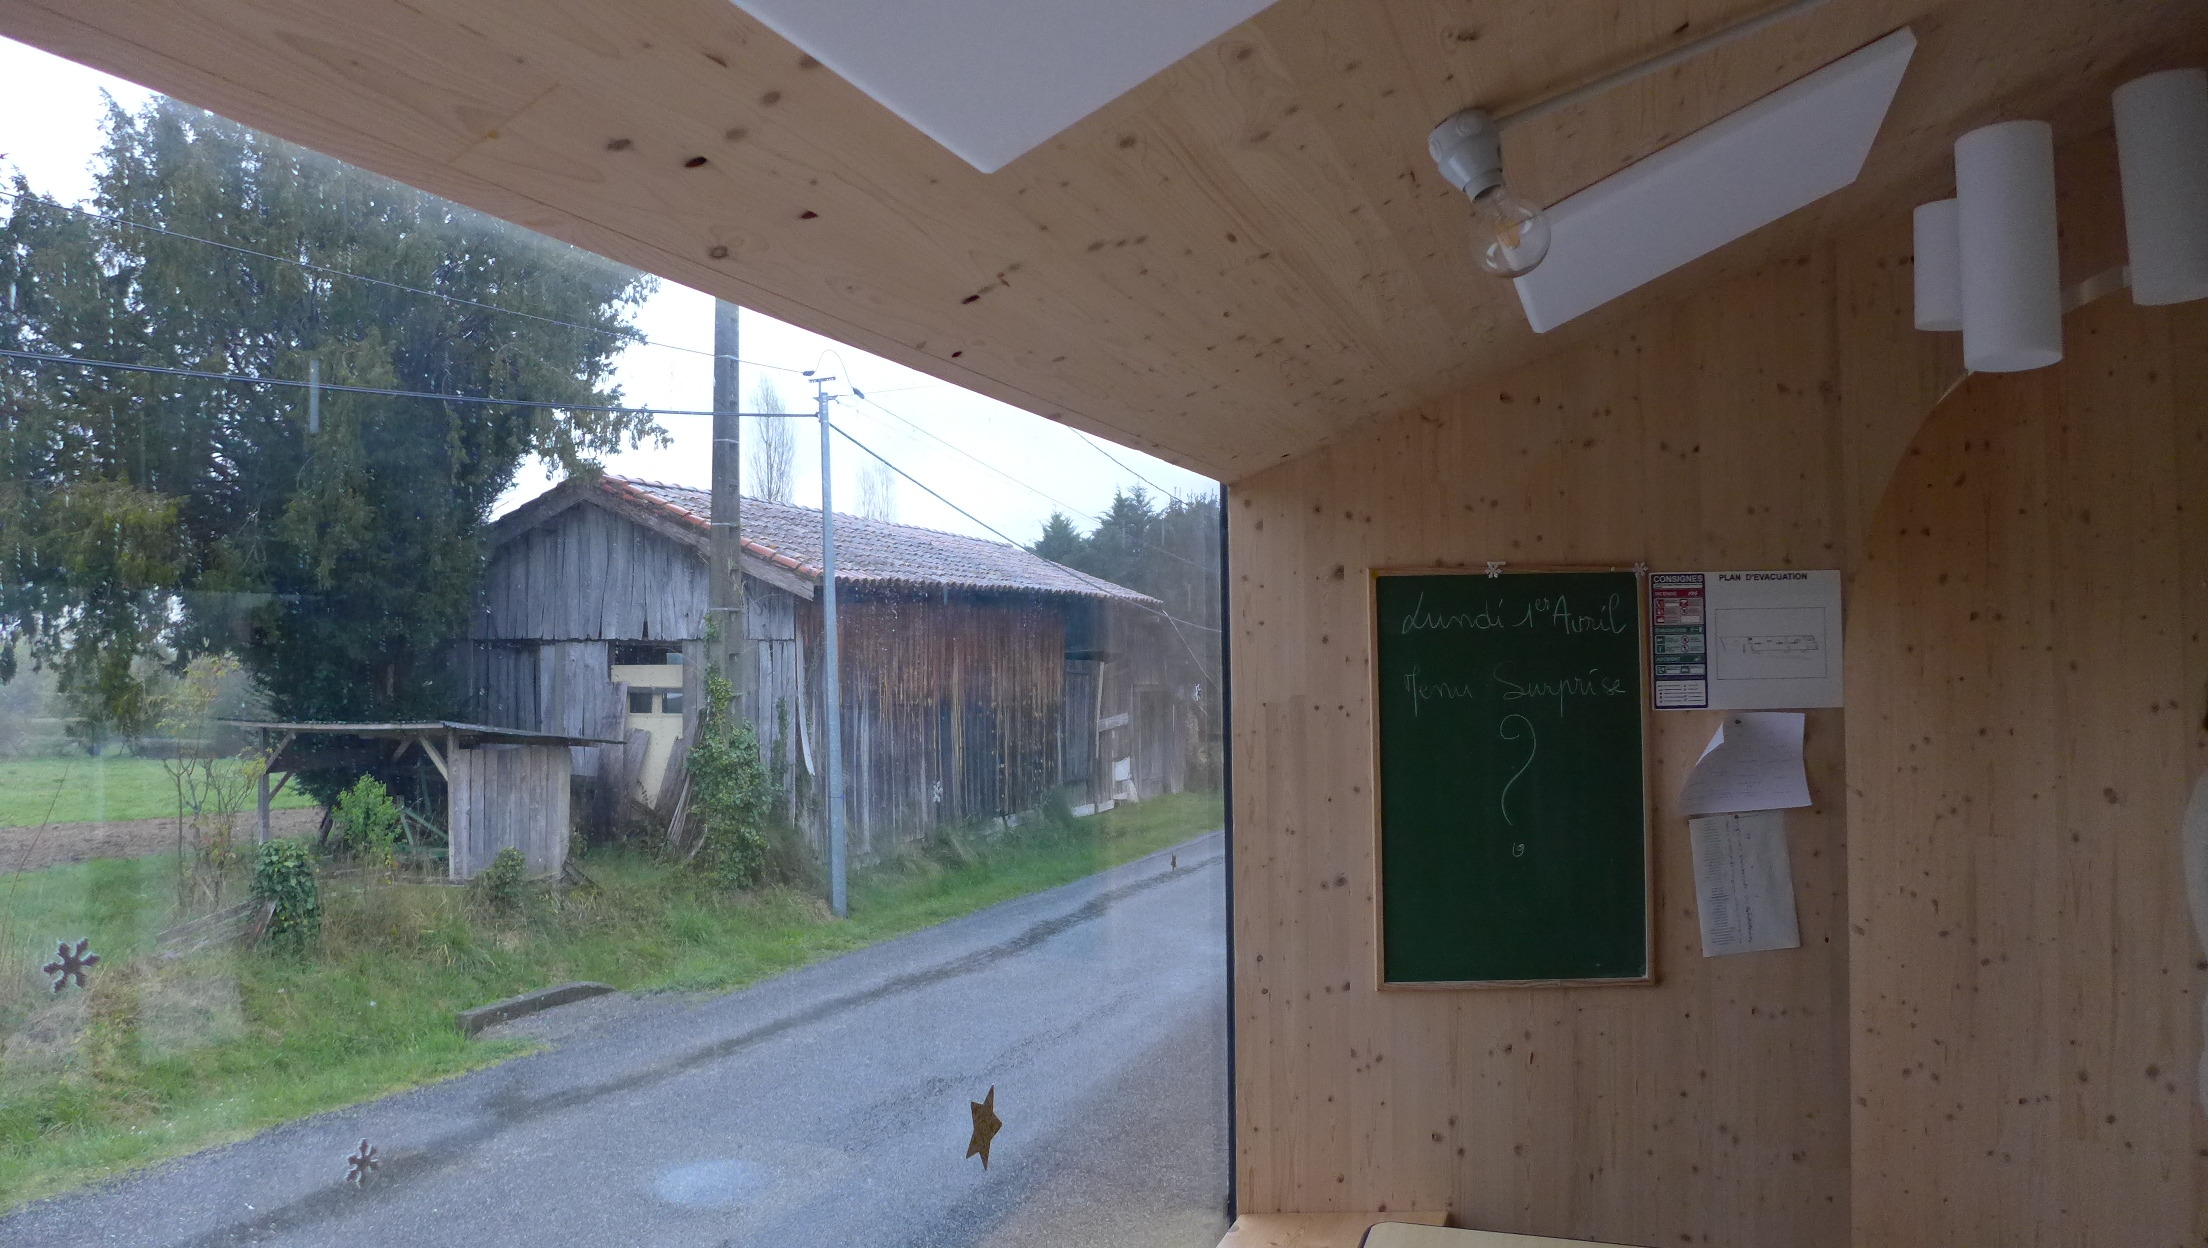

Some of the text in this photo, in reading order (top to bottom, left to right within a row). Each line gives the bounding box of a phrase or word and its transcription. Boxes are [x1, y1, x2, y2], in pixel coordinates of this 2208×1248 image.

[1653, 574, 1703, 583] CONSIGNES
[1745, 572, 1808, 581] D'EVACUATION
[1401, 591, 1504, 635] Lundi
[1552, 593, 1627, 635] Avril
[1493, 660, 1627, 718] Surprise
[1499, 713, 1537, 858] ?
